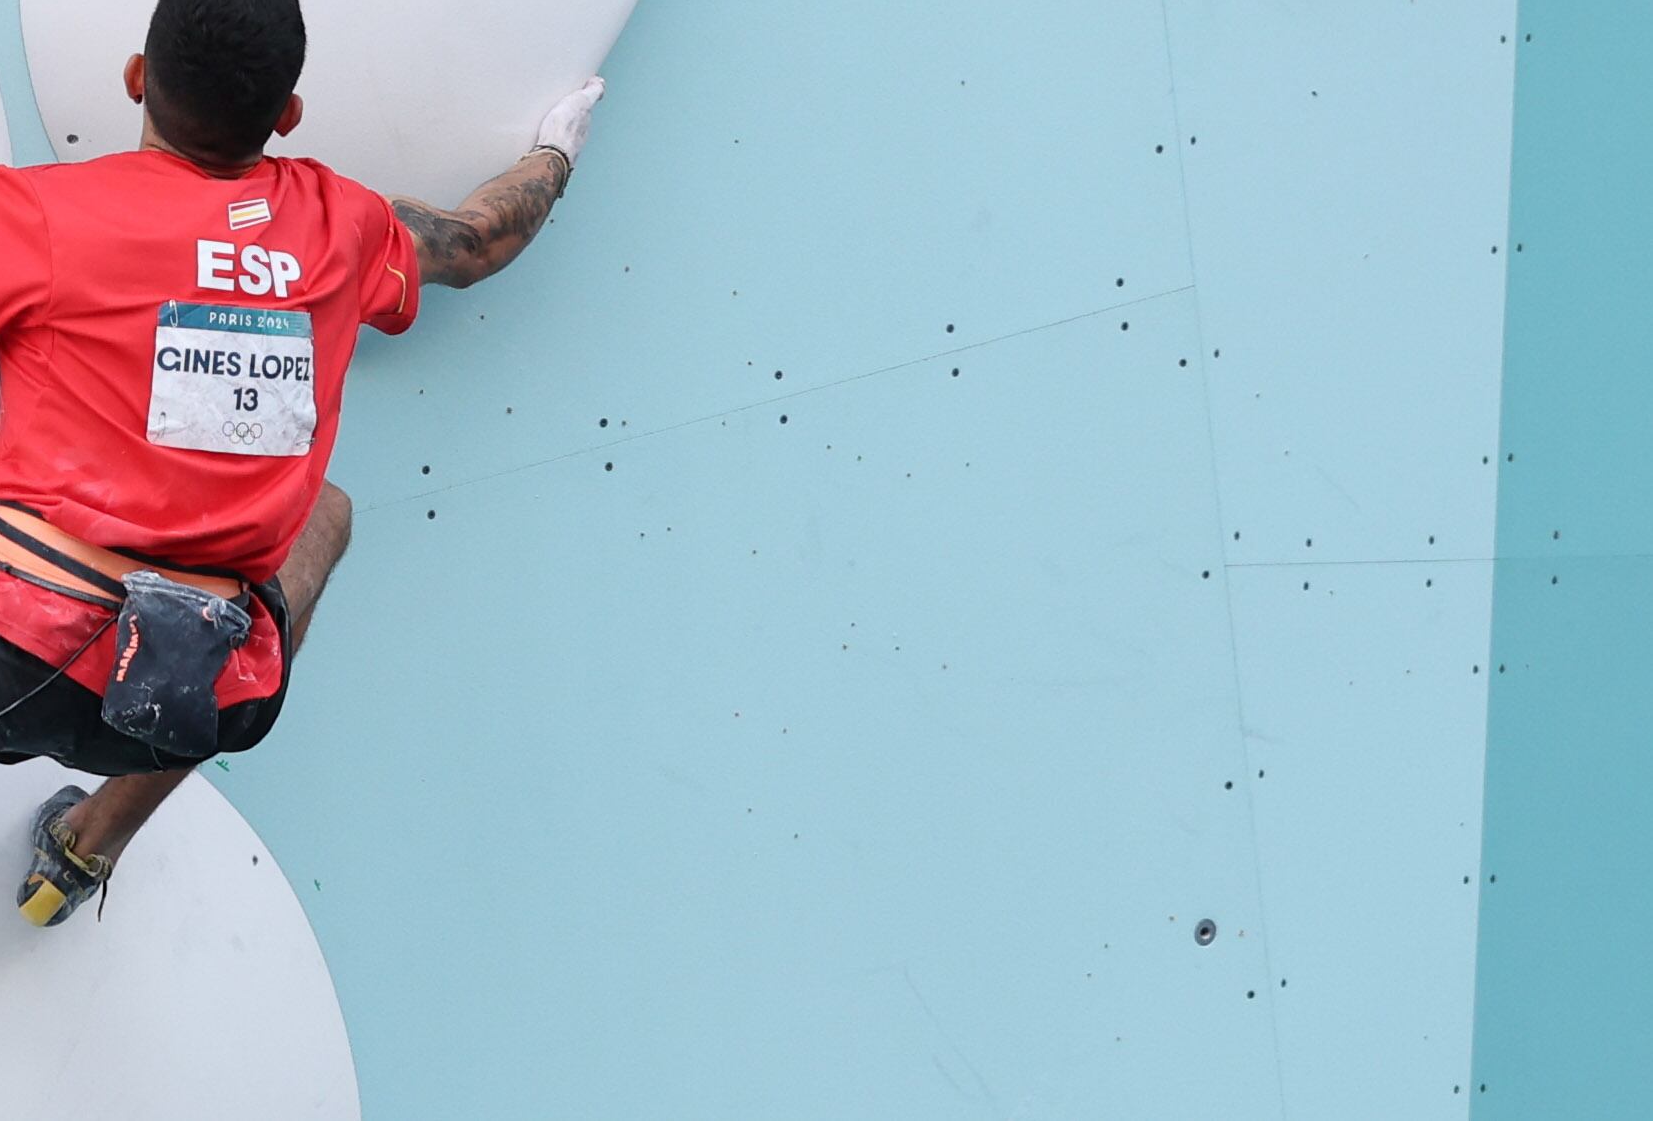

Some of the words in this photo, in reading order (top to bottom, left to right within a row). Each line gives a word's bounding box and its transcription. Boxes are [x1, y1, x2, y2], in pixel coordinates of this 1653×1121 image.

[196, 239, 302, 298] ESP
[209, 311, 252, 327] PARIS
[257, 316, 289, 329] 2024
[157, 347, 241, 376] GINES
[249, 354, 311, 381] LOPEZ
[233, 388, 259, 411] 13
